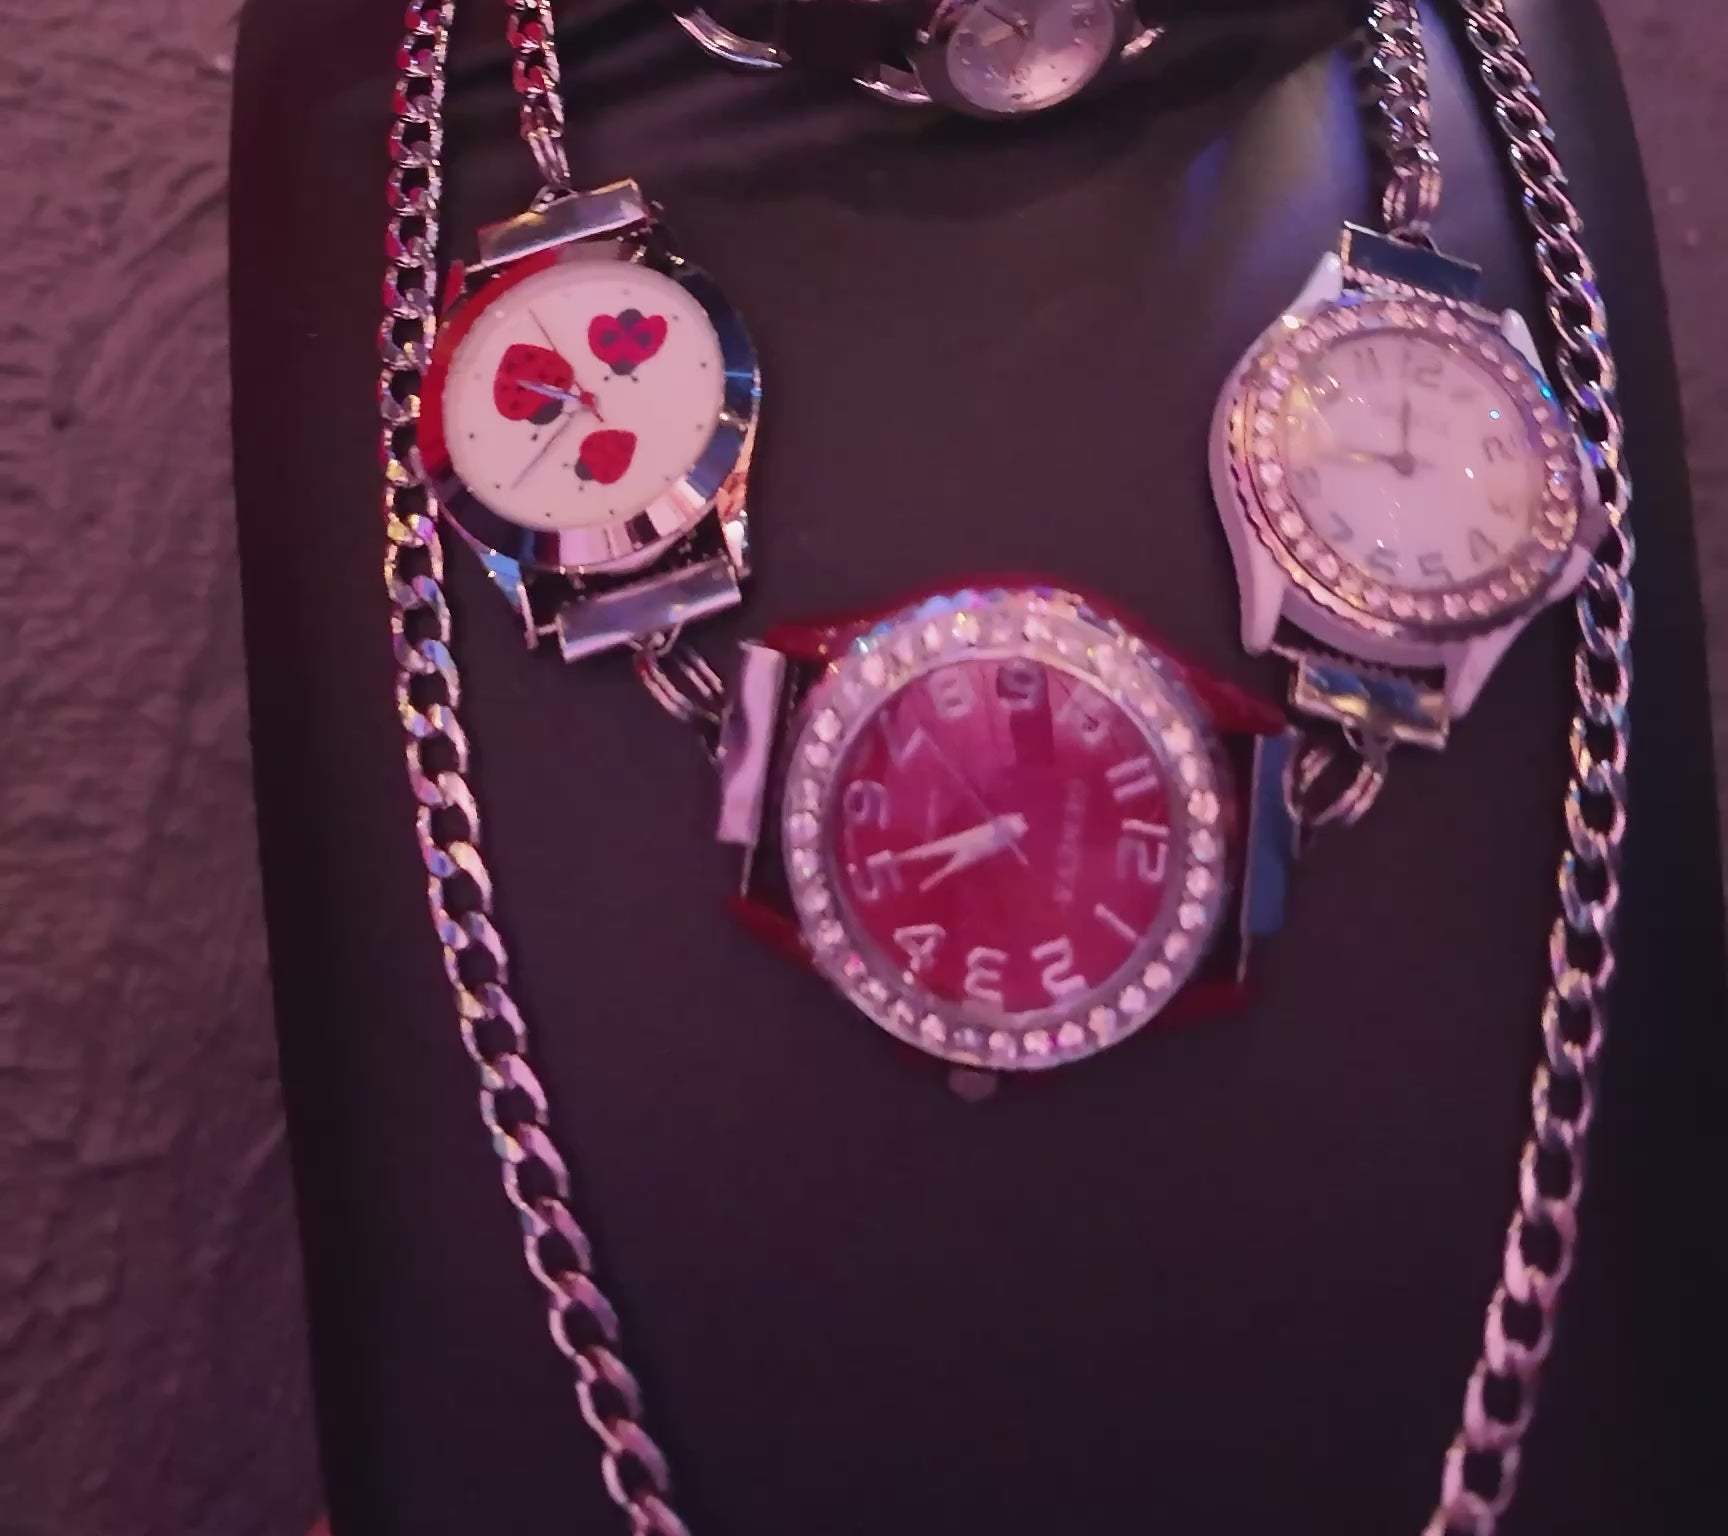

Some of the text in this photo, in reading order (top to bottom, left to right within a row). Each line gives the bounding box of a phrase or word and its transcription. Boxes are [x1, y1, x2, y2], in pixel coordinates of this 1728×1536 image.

[844, 779, 890, 831] 6
[1104, 757, 1159, 803] 11
[1115, 817, 1171, 884] 12
[892, 922, 948, 972] 4
[964, 945, 1009, 1004] 3
[1031, 935, 1092, 997] 2
